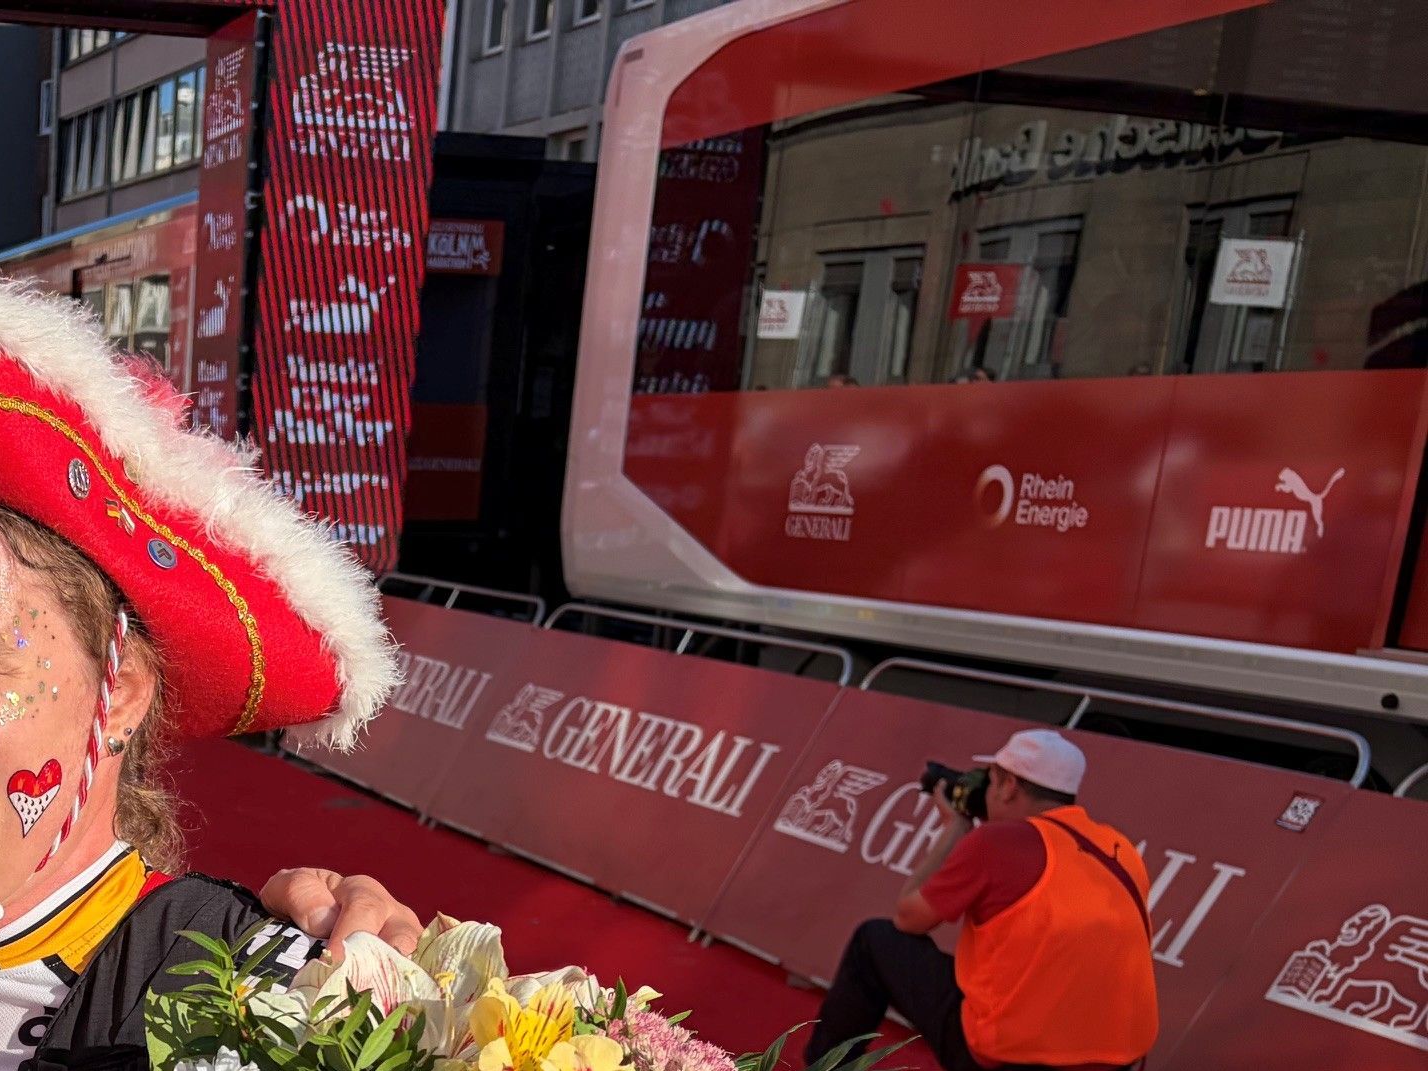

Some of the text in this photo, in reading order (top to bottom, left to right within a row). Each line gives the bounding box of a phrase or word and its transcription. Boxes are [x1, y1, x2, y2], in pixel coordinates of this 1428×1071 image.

[1020, 473, 1074, 500] Rhein
[785, 515, 853, 541] GENERALI
[1015, 500, 1089, 532] Energie
[1205, 506, 1307, 554] PUMA
[541, 695, 781, 817] GENERALI
